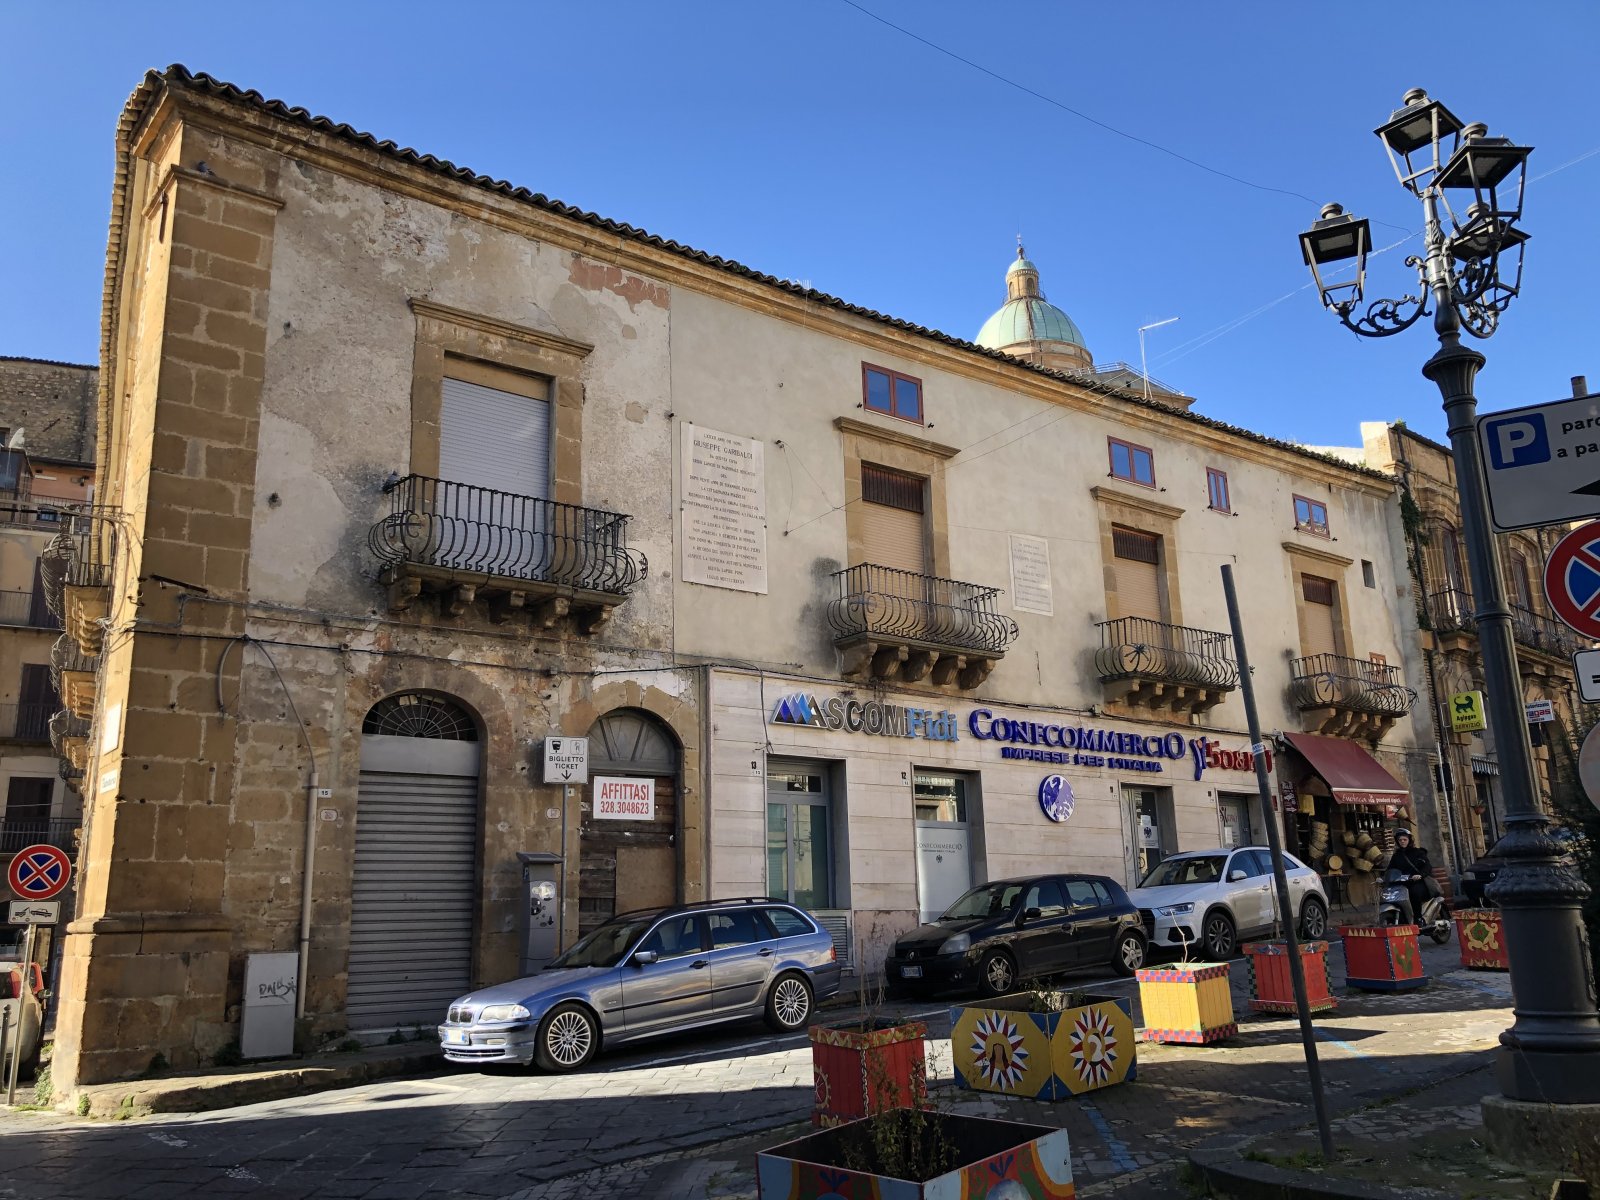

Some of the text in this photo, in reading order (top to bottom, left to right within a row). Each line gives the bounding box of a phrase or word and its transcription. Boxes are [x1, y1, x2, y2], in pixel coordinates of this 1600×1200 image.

[693, 439, 752, 459] GIUSEPPE GARIBALDI
[1496, 421, 1536, 464] P
[1557, 448, 1568, 458] a
[548, 755, 584, 763] BIGLIETTO
[1001, 747, 1070, 764] IMPRESE
[1073, 753, 1105, 767] PER
[601, 782, 650, 801] AFFITTASI
[600, 801, 649, 814] 328.3048623
